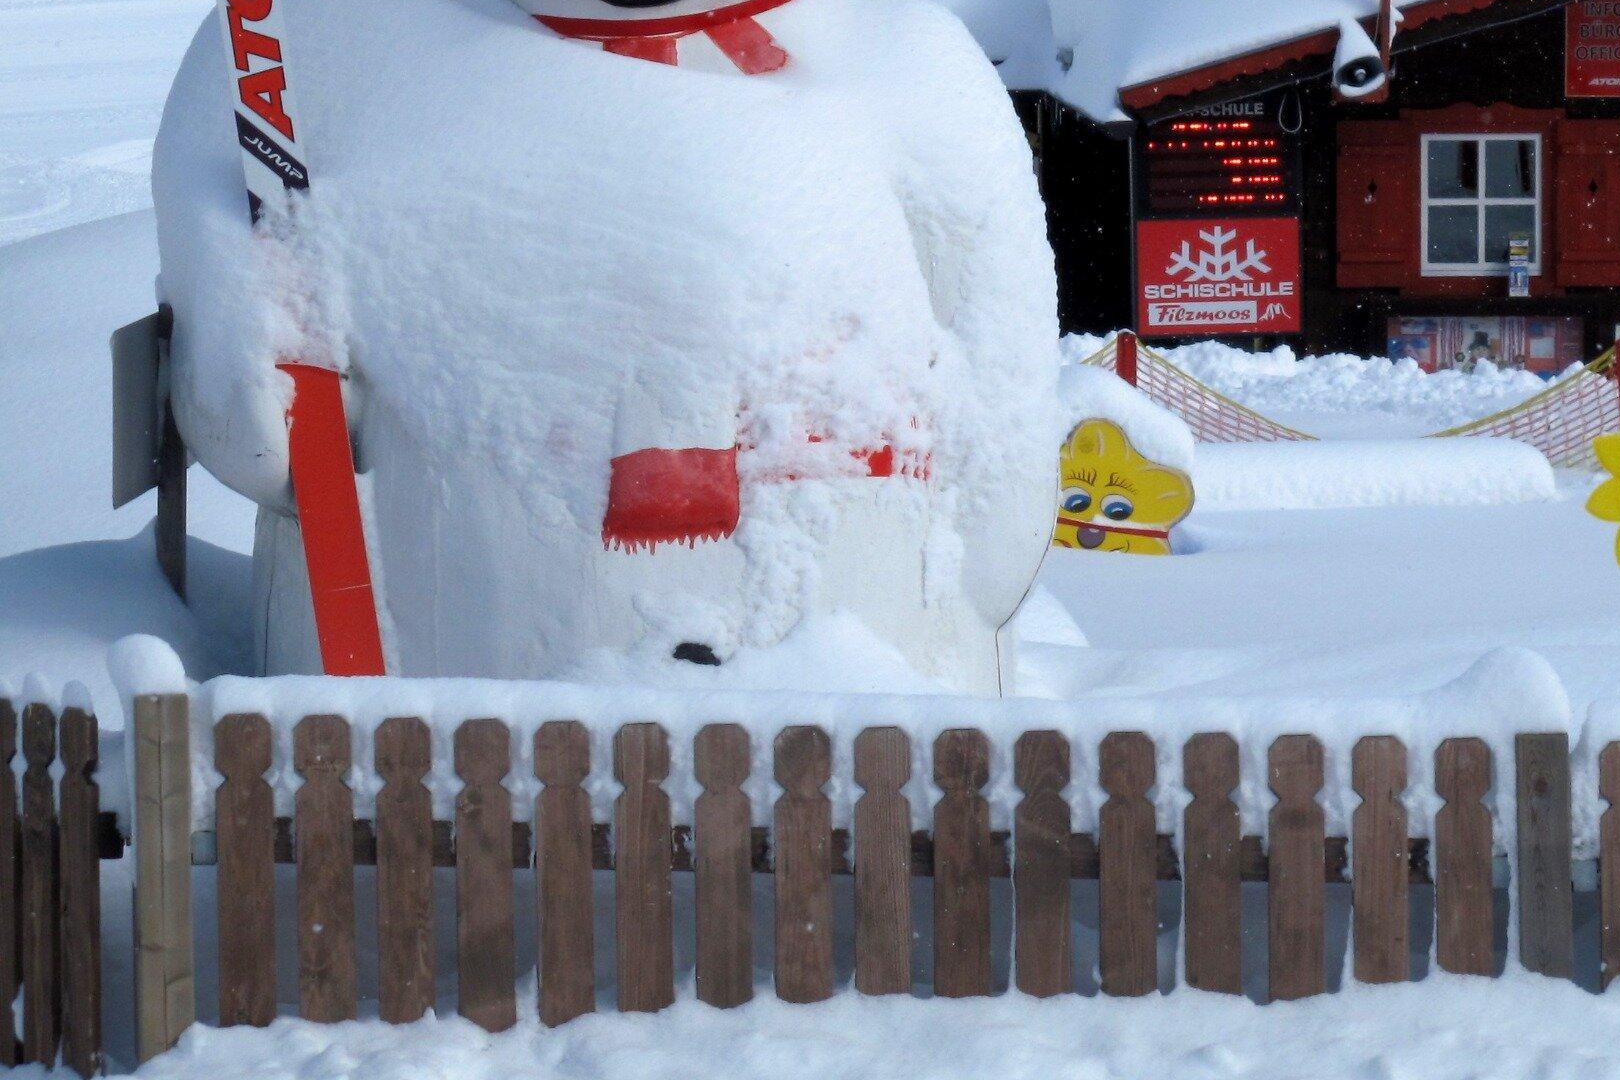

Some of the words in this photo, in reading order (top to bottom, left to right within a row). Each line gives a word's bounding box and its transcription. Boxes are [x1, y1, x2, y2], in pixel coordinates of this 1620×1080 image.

[244, 135, 304, 180] JUMP
[1144, 281, 1294, 299] SCHISCHULE
[1155, 304, 1251, 323] Filzmoos
